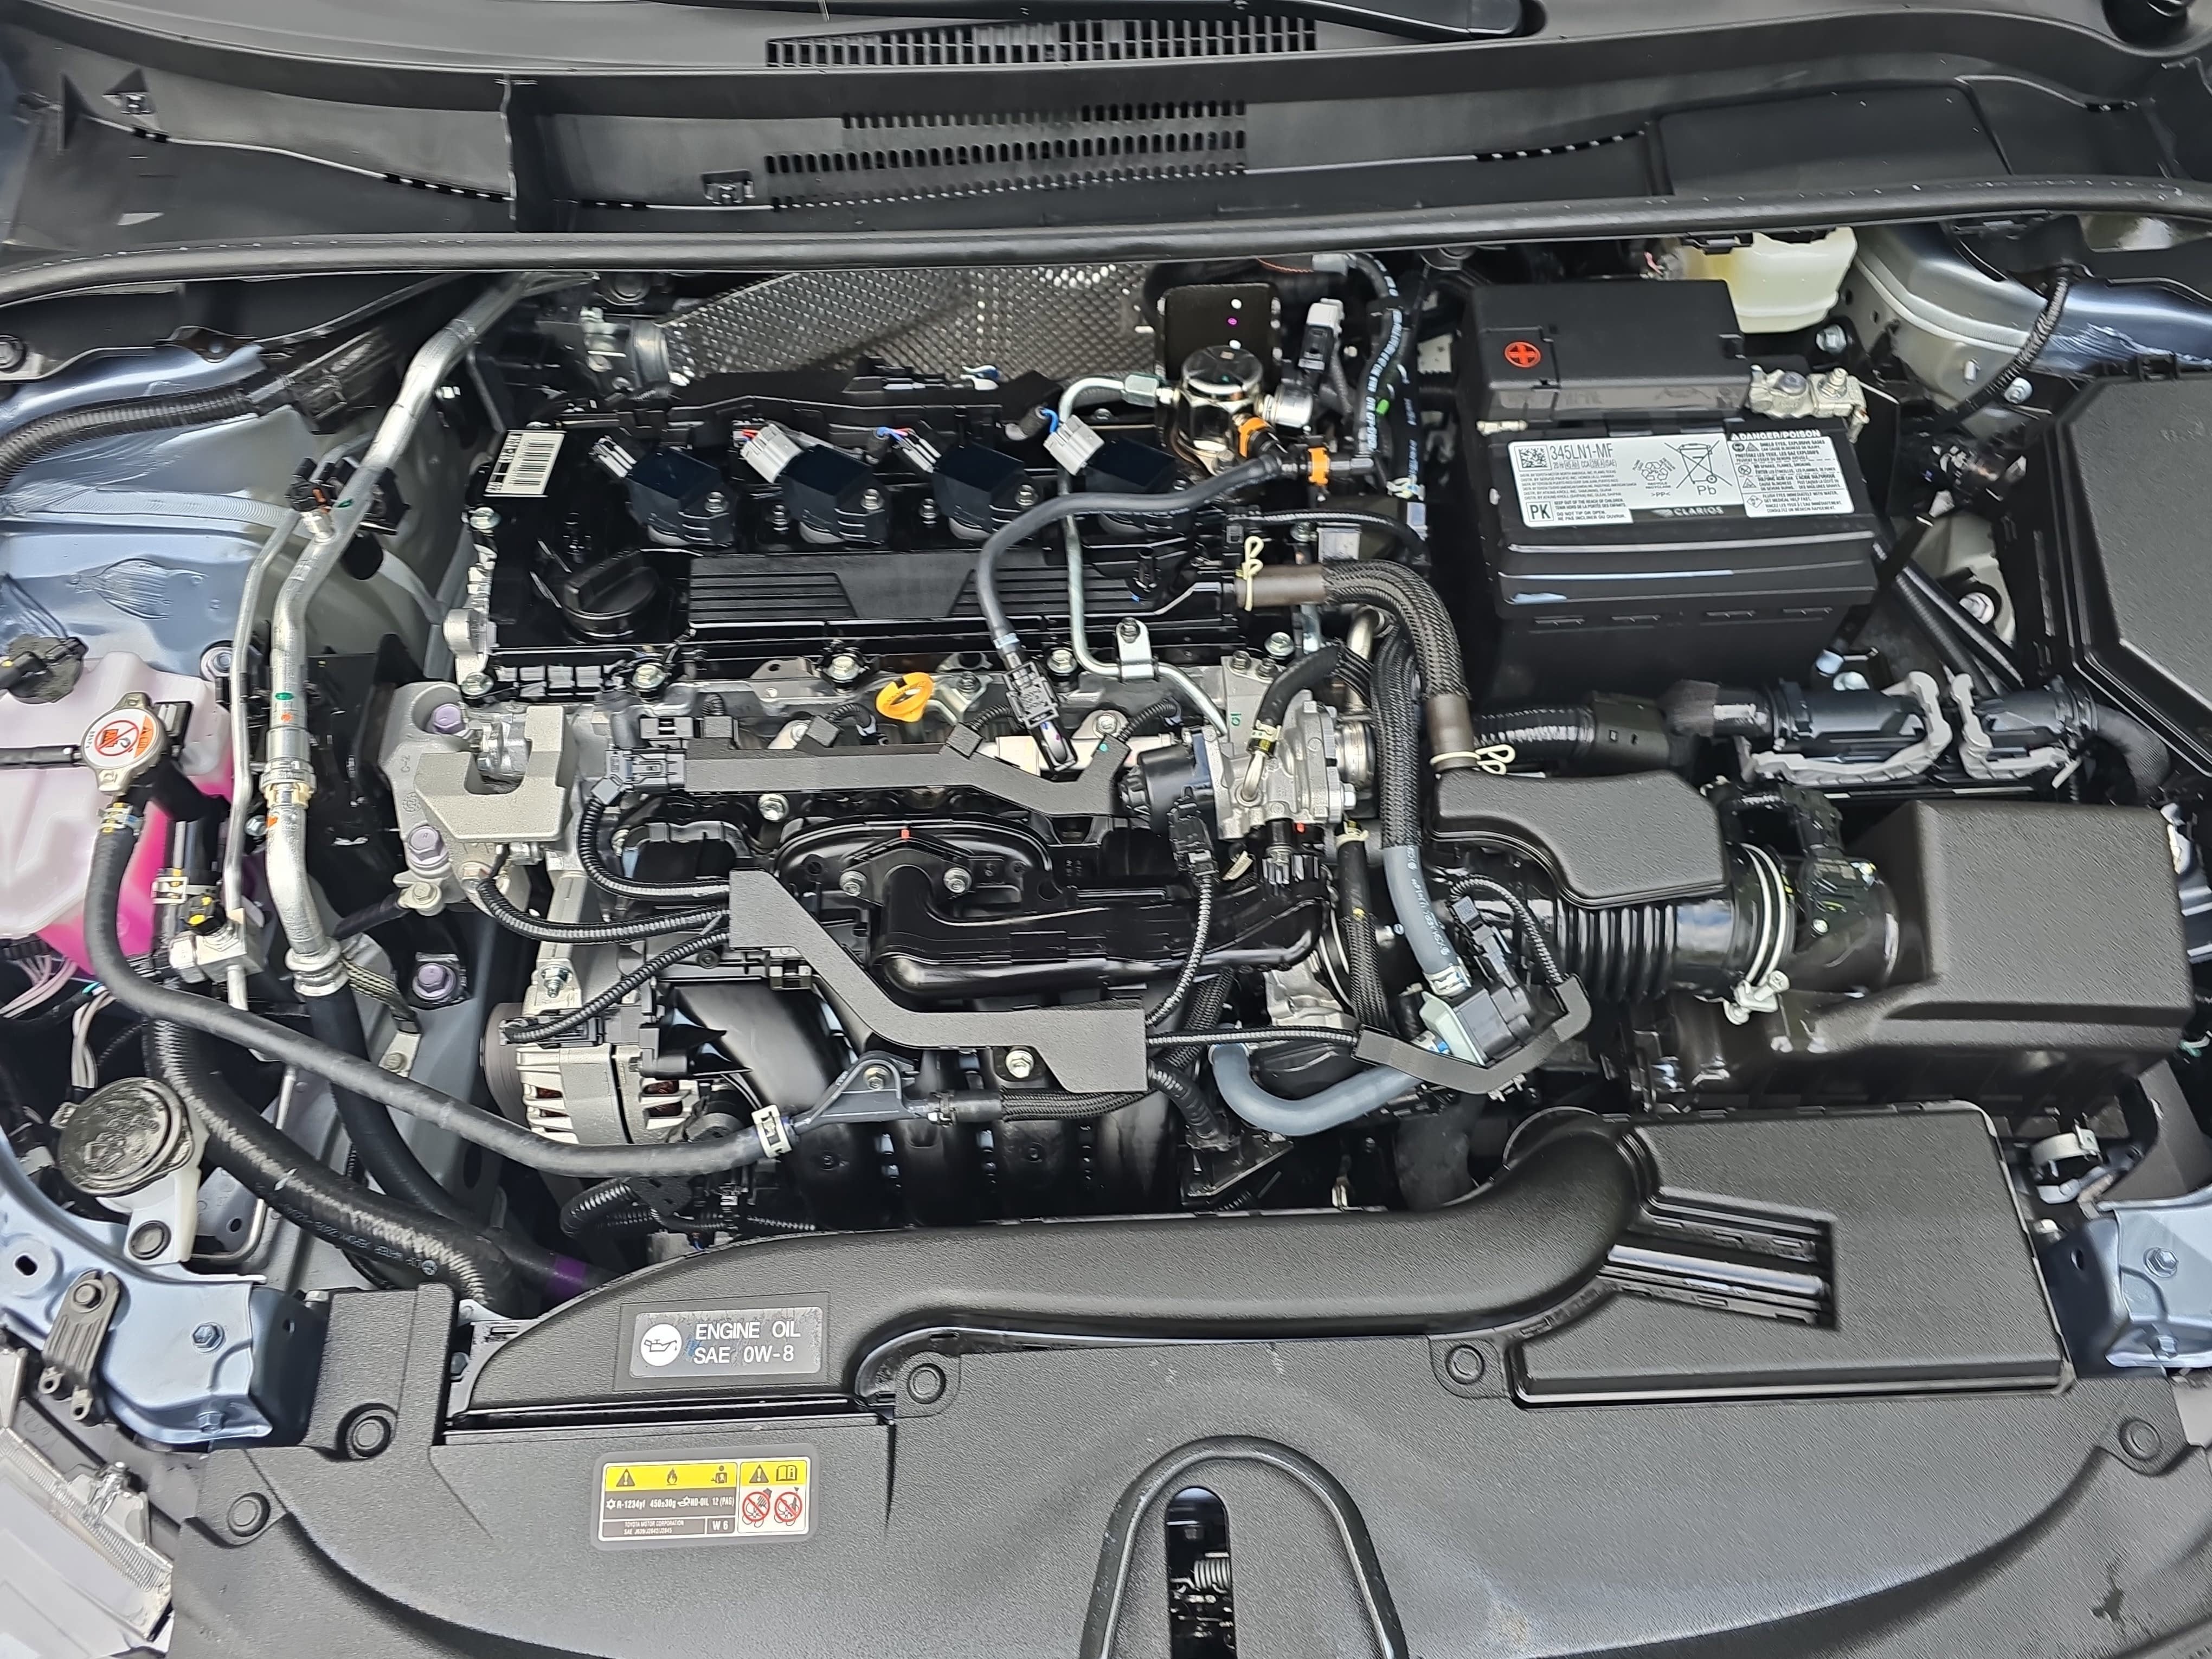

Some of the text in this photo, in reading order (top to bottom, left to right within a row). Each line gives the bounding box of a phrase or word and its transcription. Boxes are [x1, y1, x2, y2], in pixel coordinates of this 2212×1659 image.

[1739, 429, 1821, 440] DANGER/POISON
[1549, 442, 1613, 460] 345LN1-MF
[1696, 485, 1716, 496] Pb
[1529, 504, 1551, 519] PK
[1674, 506, 1724, 515] CLARIOS
[696, 1320, 801, 1340] ENGINE OIL
[693, 1345, 794, 1364] SAE 0W-8
[712, 1497, 719, 1506] 12
[719, 1496, 735, 1507] (PAG)
[712, 1520, 728, 1530] W 6
